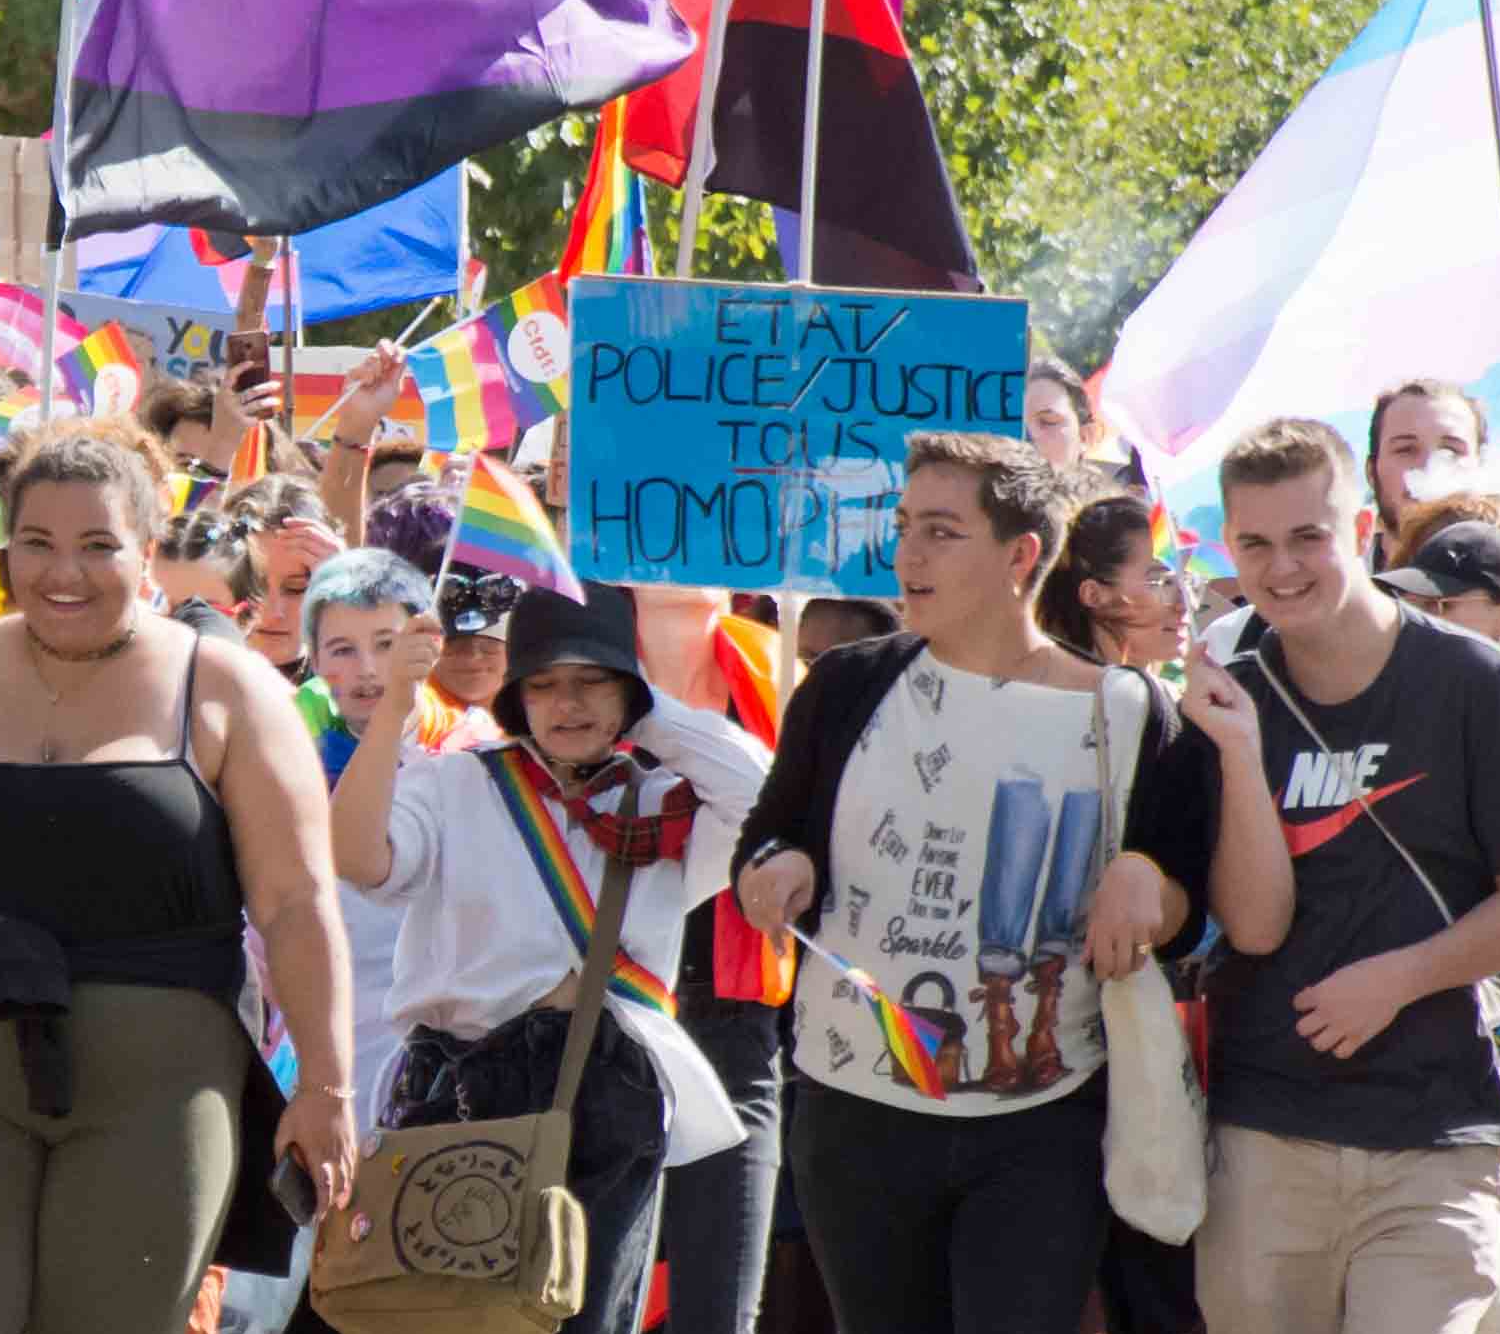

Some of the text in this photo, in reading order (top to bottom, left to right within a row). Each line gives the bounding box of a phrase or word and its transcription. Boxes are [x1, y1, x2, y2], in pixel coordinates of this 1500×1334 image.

[588, 343, 1026, 423] POLICE/JUSTICE
[716, 419, 880, 469] TOUS
[1283, 743, 1391, 810] NIKE
[911, 867, 956, 900] EVER
[878, 915, 969, 962] Sparkle
